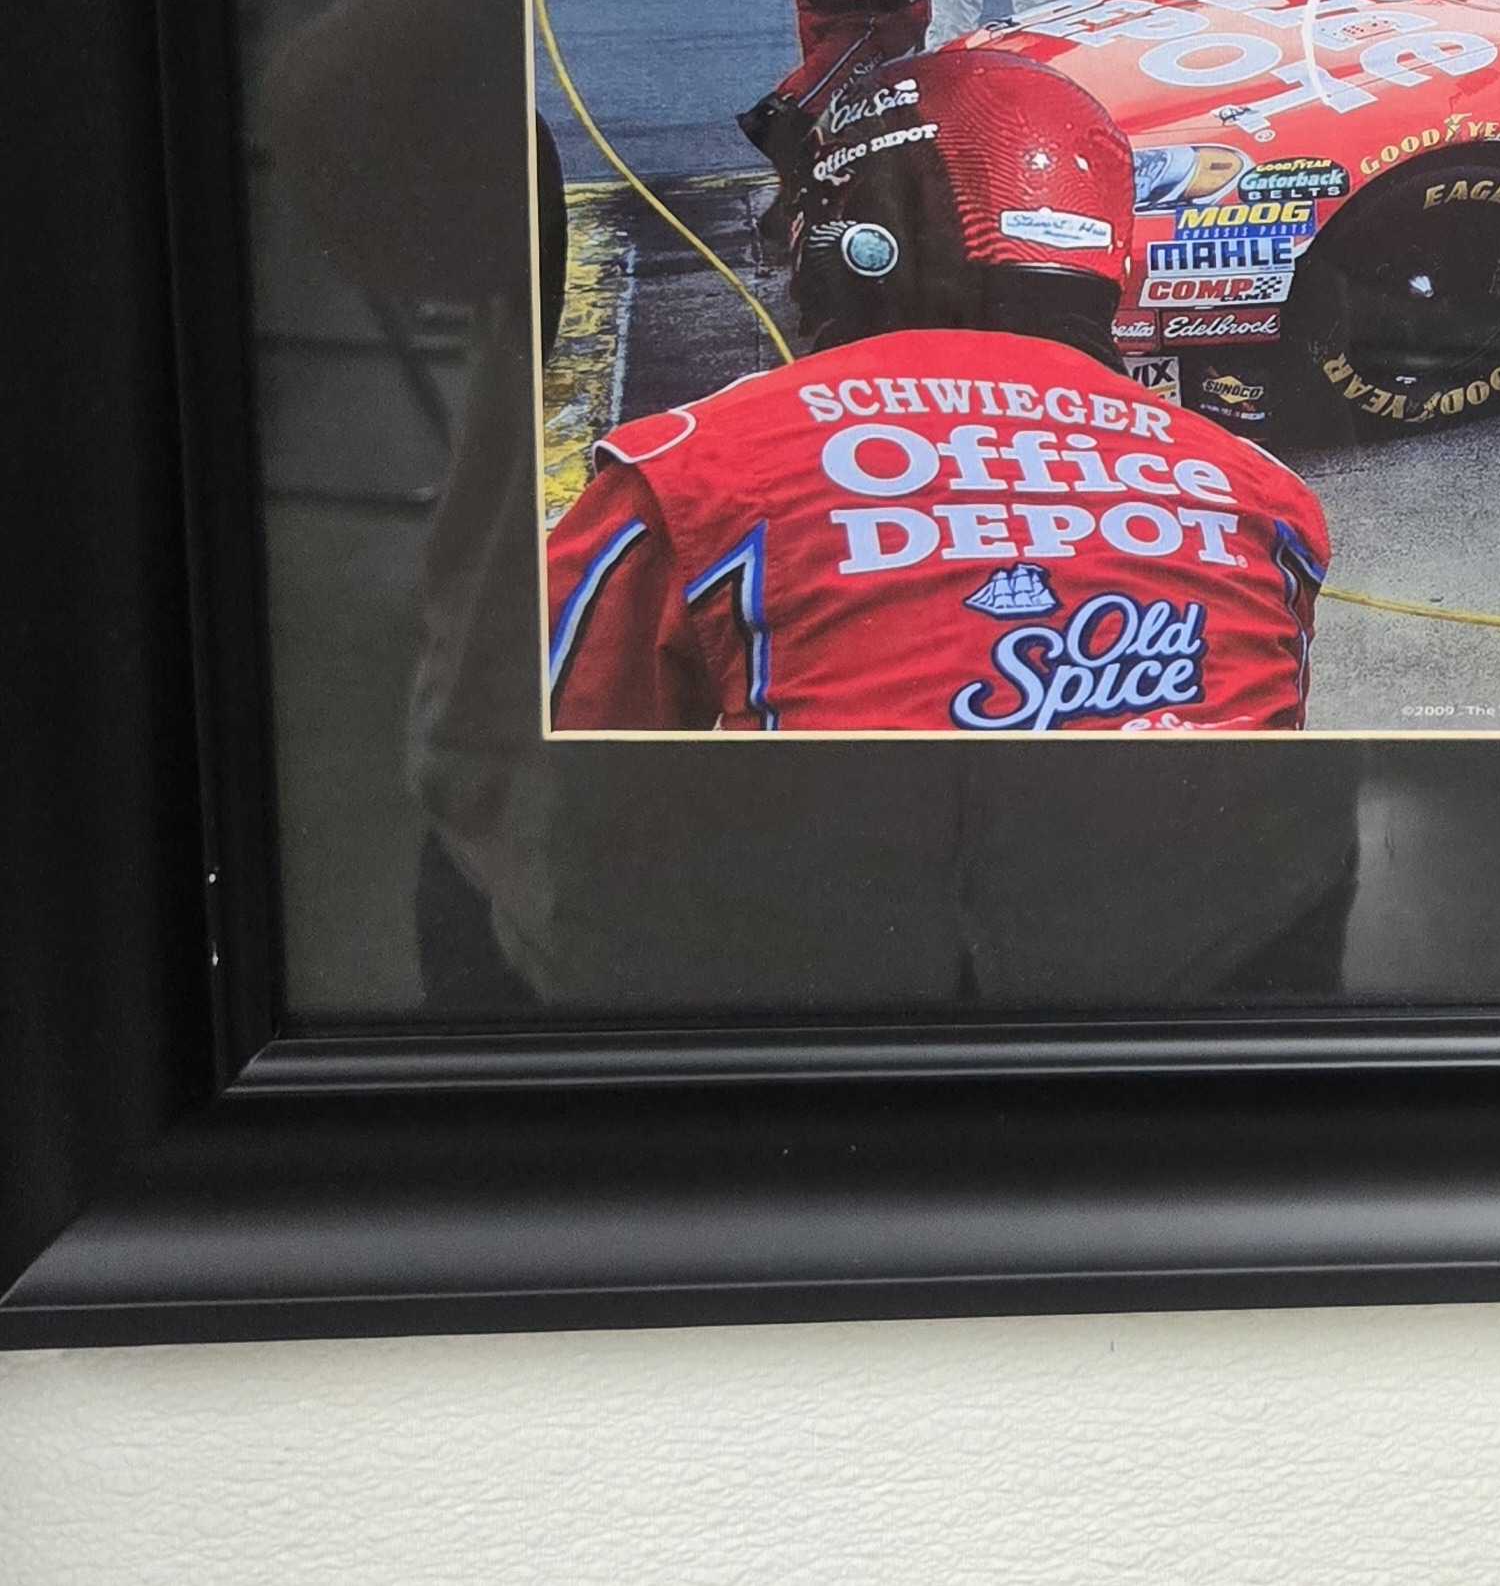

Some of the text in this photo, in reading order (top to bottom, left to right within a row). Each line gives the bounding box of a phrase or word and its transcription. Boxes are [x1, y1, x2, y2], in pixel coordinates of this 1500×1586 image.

[1240, 169, 1345, 191] Gatorback
[1248, 186, 1341, 200] BELTS
[1177, 200, 1315, 230] MOOG
[1150, 236, 1294, 271] MAHLE
[1148, 278, 1255, 301] COMP
[1163, 313, 1280, 339] Edelbrock
[1203, 379, 1263, 400] SUNOCO
[798, 375, 1176, 445] SCHWIEGER
[820, 422, 1240, 504] Office
[828, 501, 1243, 576] DEPOT
[1066, 593, 1203, 665] Old
[953, 624, 1201, 731] Spice
